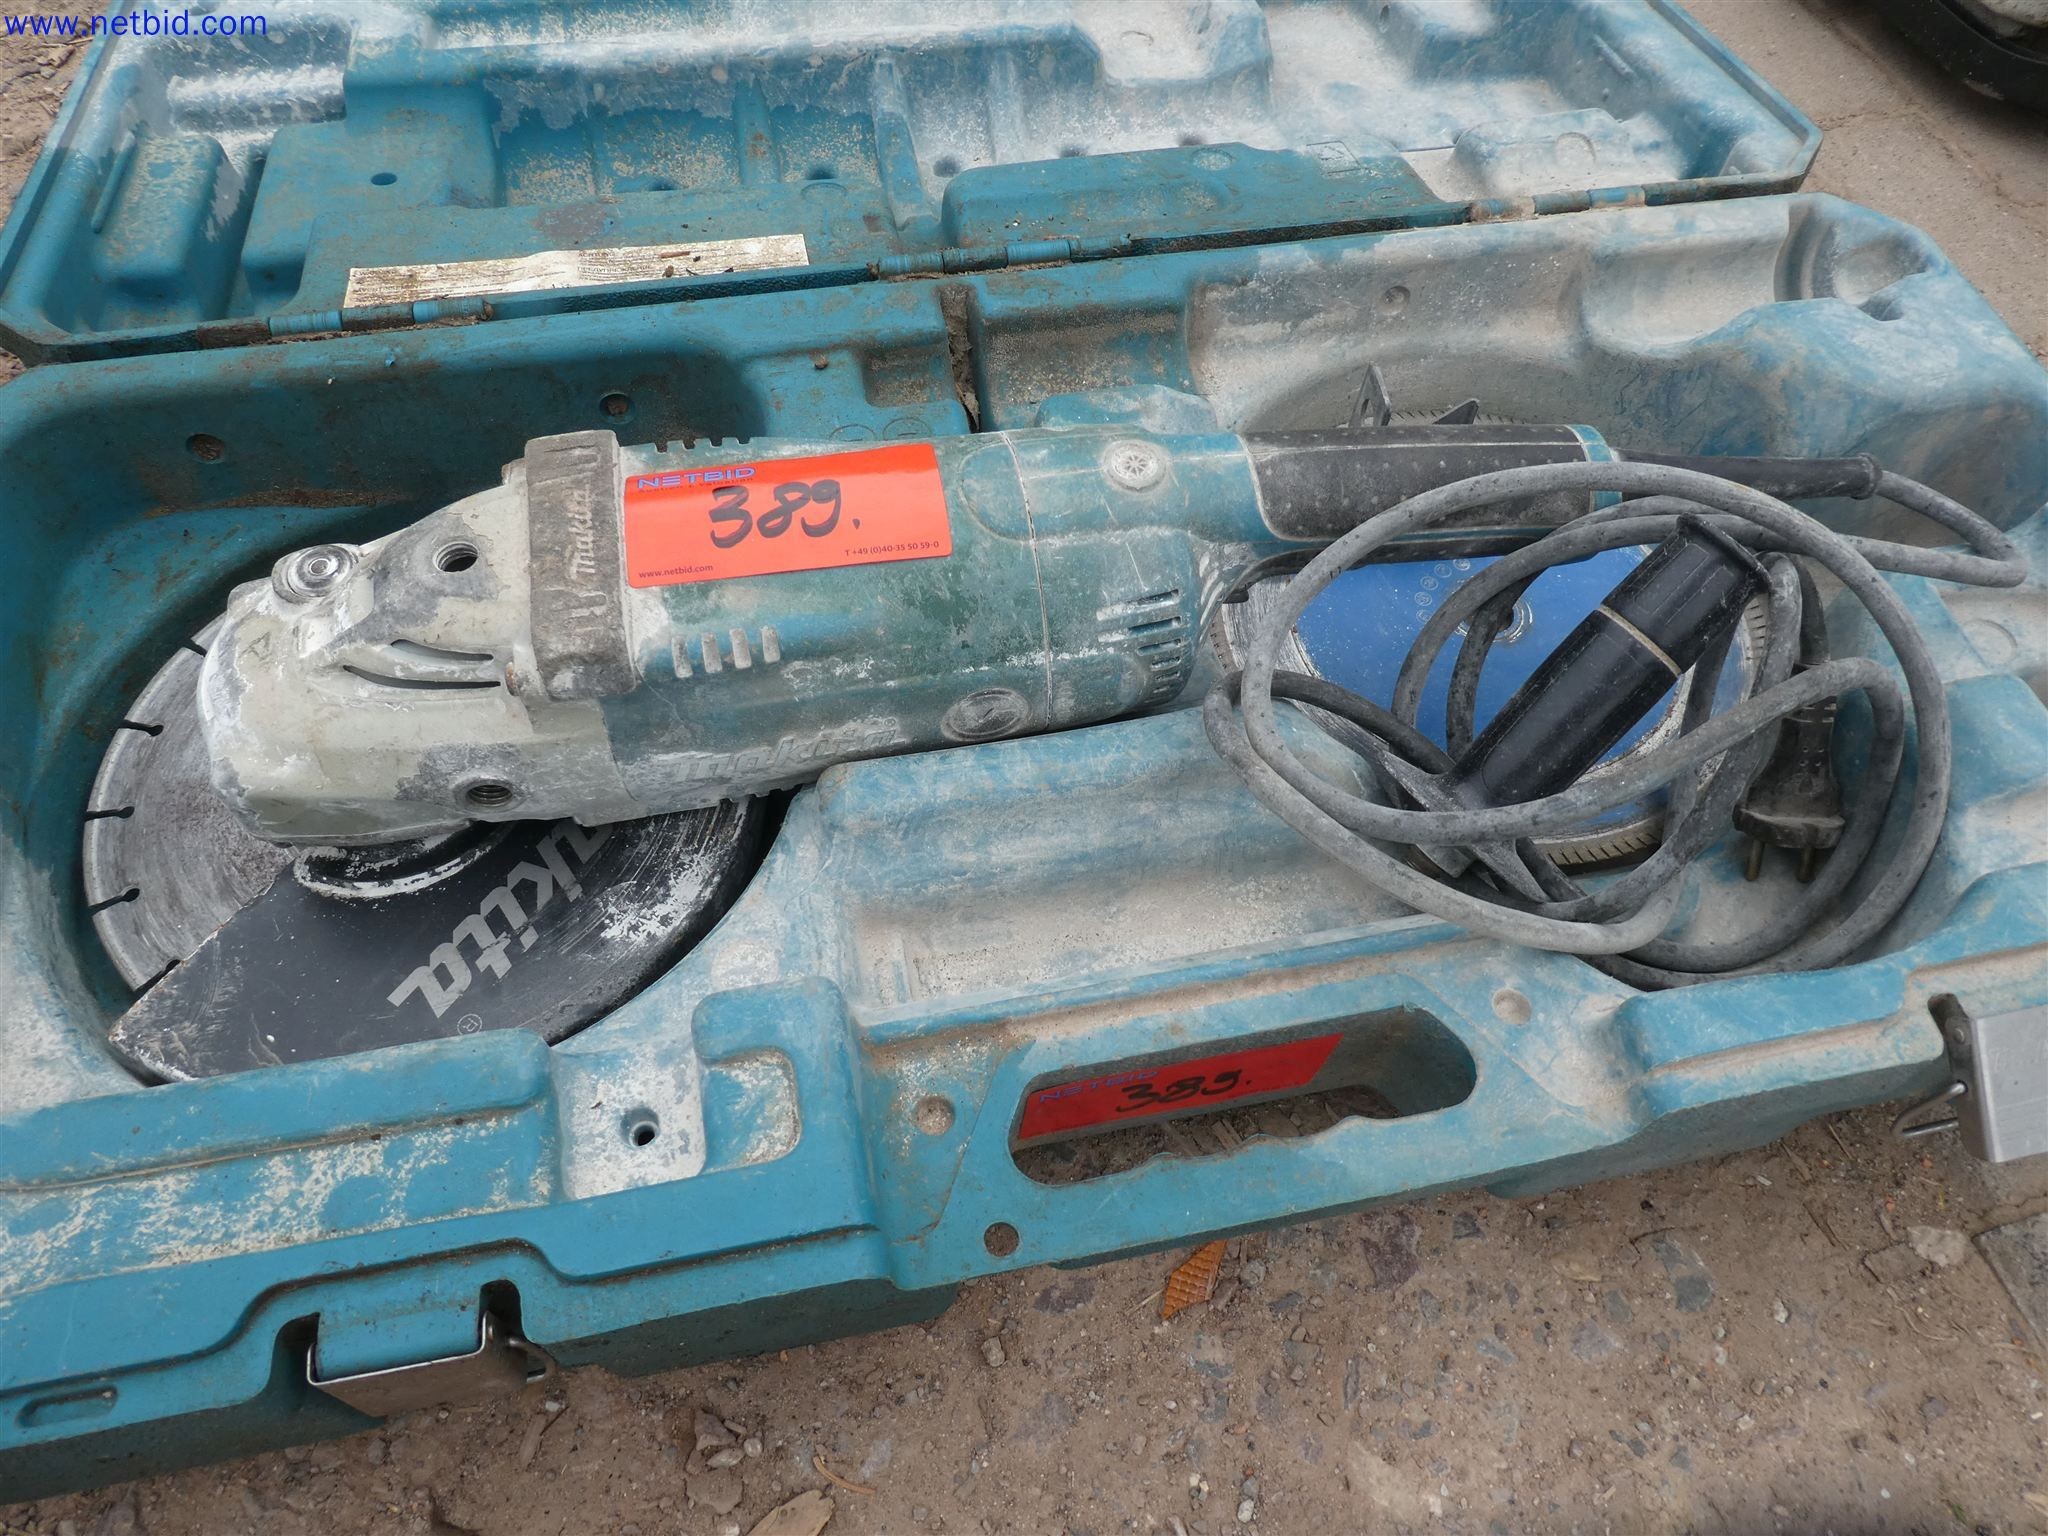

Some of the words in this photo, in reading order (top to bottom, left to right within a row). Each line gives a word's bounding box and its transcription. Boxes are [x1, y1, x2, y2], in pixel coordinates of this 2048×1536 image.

[637, 467, 756, 489] NETBID
[852, 547, 868, 556] +49
[870, 543, 906, 555] (0)40-35
[907, 542, 918, 551] 50
[920, 540, 940, 550] 59-0
[639, 563, 714, 579] www.netbid.com
[387, 819, 613, 1018] akita
